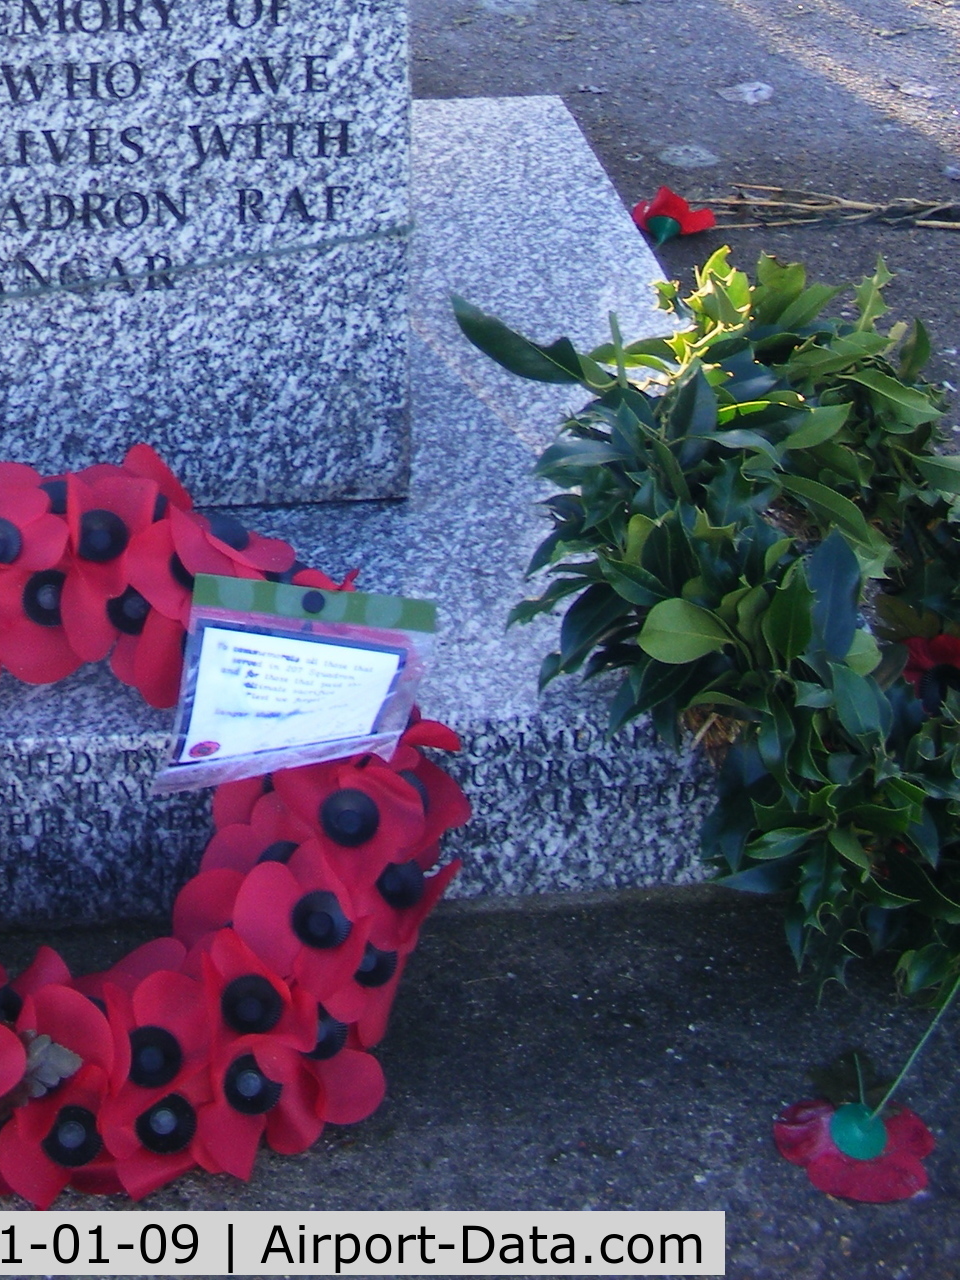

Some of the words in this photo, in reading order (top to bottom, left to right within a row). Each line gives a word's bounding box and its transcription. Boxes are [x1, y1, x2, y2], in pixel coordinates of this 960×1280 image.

[0, 59, 143, 103] WHO
[187, 55, 332, 98] GAVE
[189, 120, 355, 170] WITH
[237, 185, 351, 226] RAF
